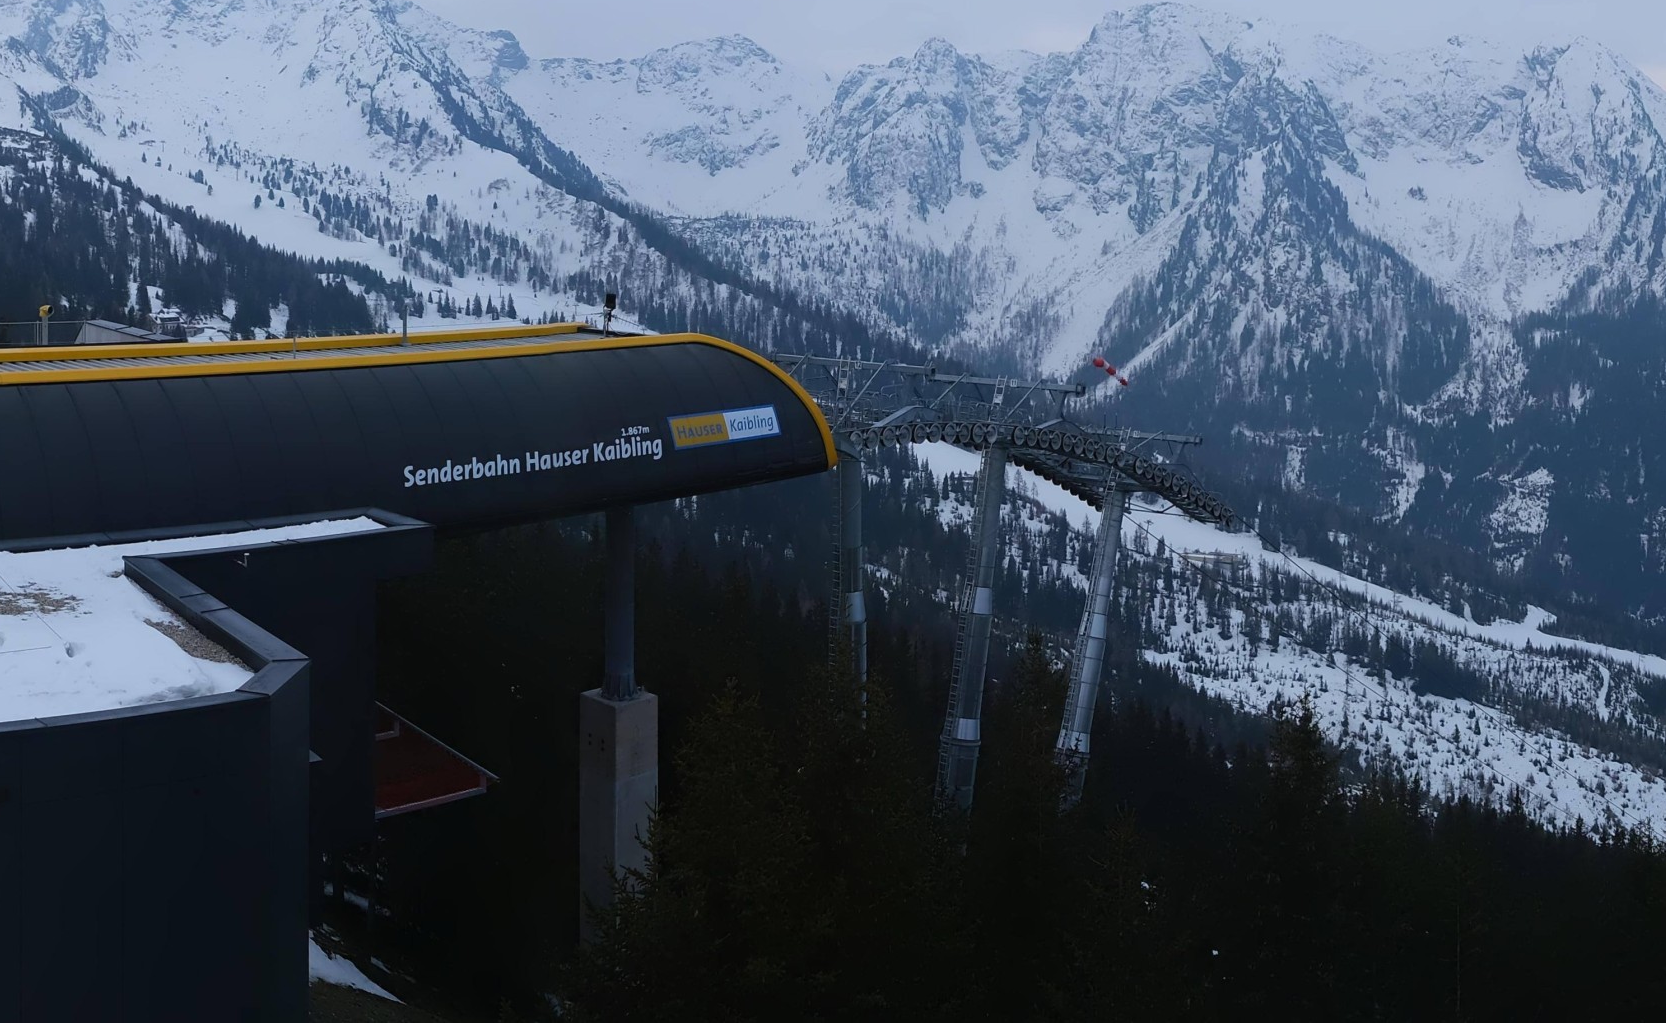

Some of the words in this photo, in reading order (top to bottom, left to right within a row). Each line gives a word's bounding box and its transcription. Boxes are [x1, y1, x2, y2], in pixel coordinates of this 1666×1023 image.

[621, 425, 650, 437] 1.867m
[676, 424, 723, 439] HAUSER
[729, 415, 774, 432] Kaibling
[403, 454, 521, 488] Senderbahn
[525, 448, 589, 472] Hauser
[593, 436, 663, 460] Kaibling
